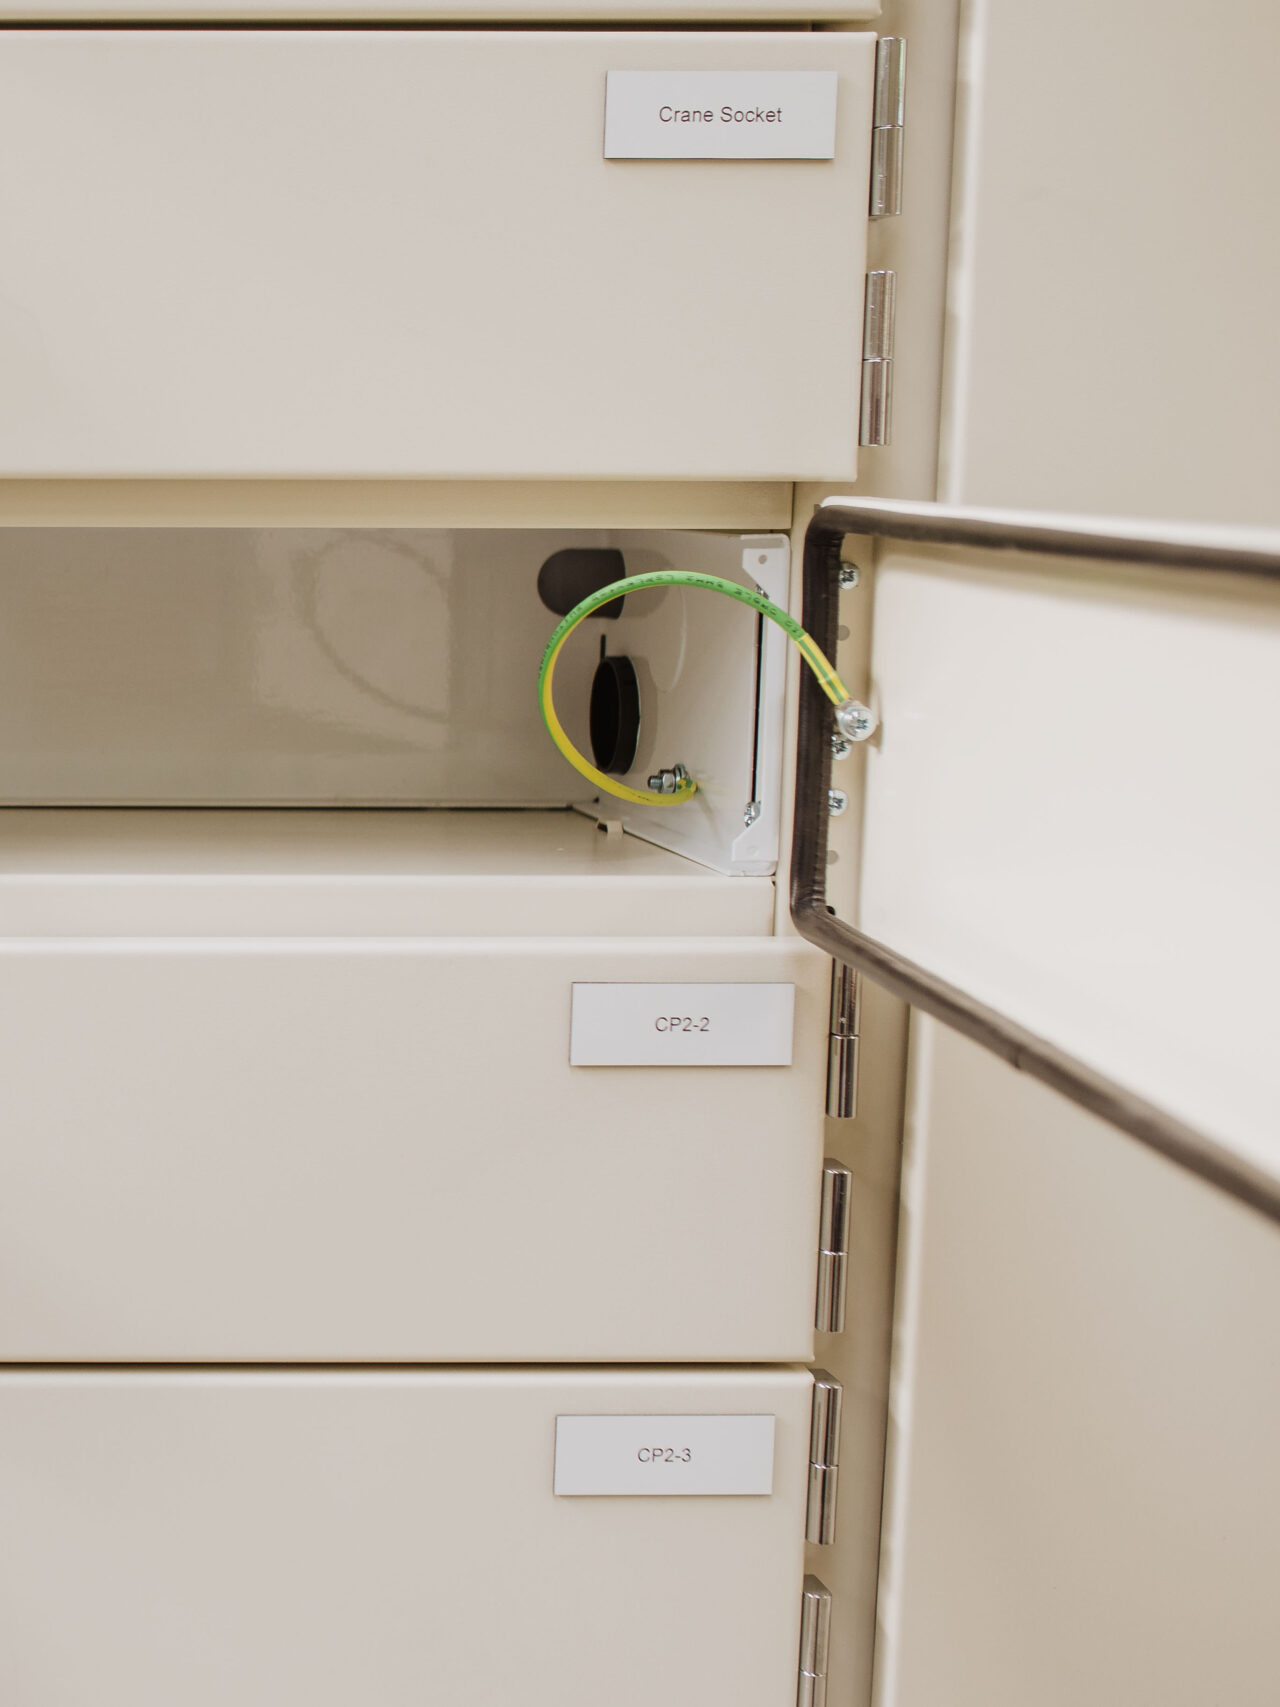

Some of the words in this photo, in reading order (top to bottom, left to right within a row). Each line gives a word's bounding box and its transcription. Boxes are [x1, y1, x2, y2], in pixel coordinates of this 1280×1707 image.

[659, 106, 714, 122] Crane
[720, 107, 782, 122] Socket
[655, 1017, 710, 1032] CP2-2
[638, 1448, 691, 1462] CP2-3
